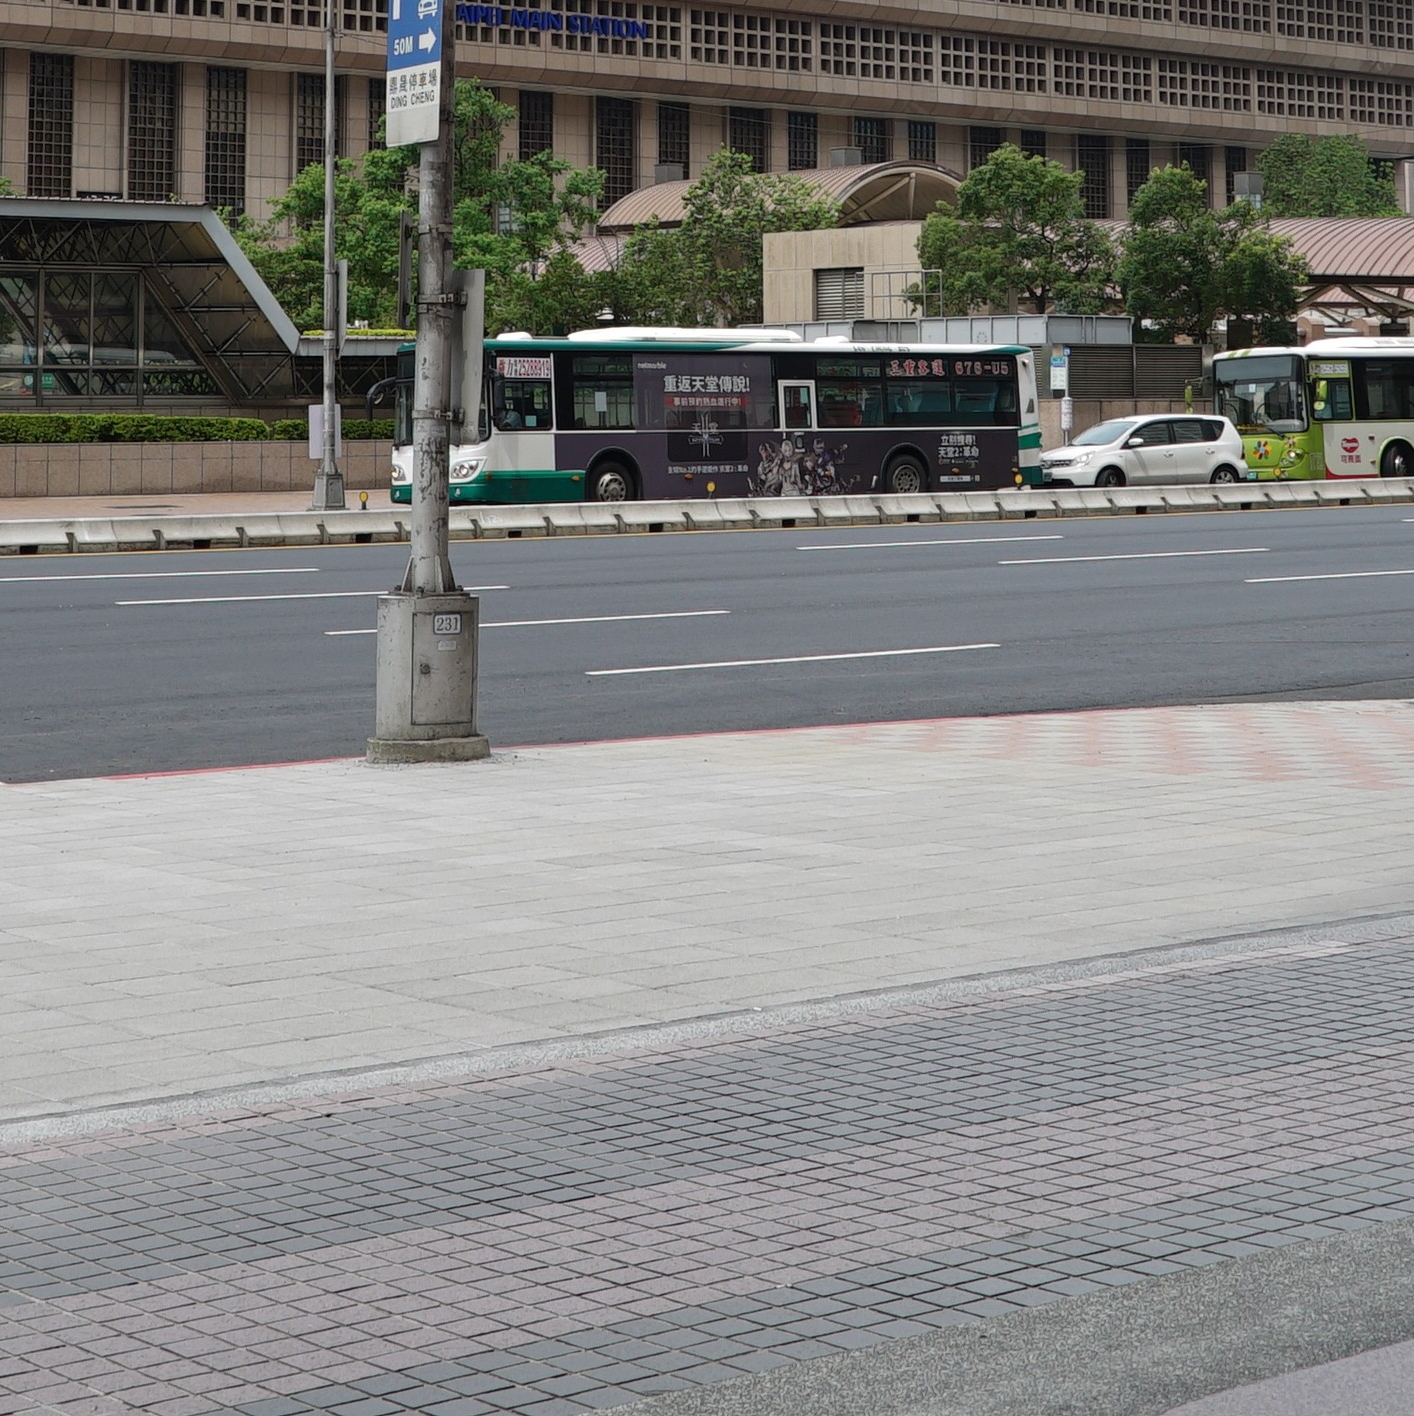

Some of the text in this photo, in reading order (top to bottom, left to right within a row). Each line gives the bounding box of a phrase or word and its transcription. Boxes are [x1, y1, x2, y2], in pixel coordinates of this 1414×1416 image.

[456, 3, 648, 39] AIPEI MAIN STATION
[393, 35, 413, 56] 50M
[390, 89, 435, 109] DING CHENG
[663, 374, 750, 393] 重返天堂傳說!
[436, 616, 459, 631] 231
